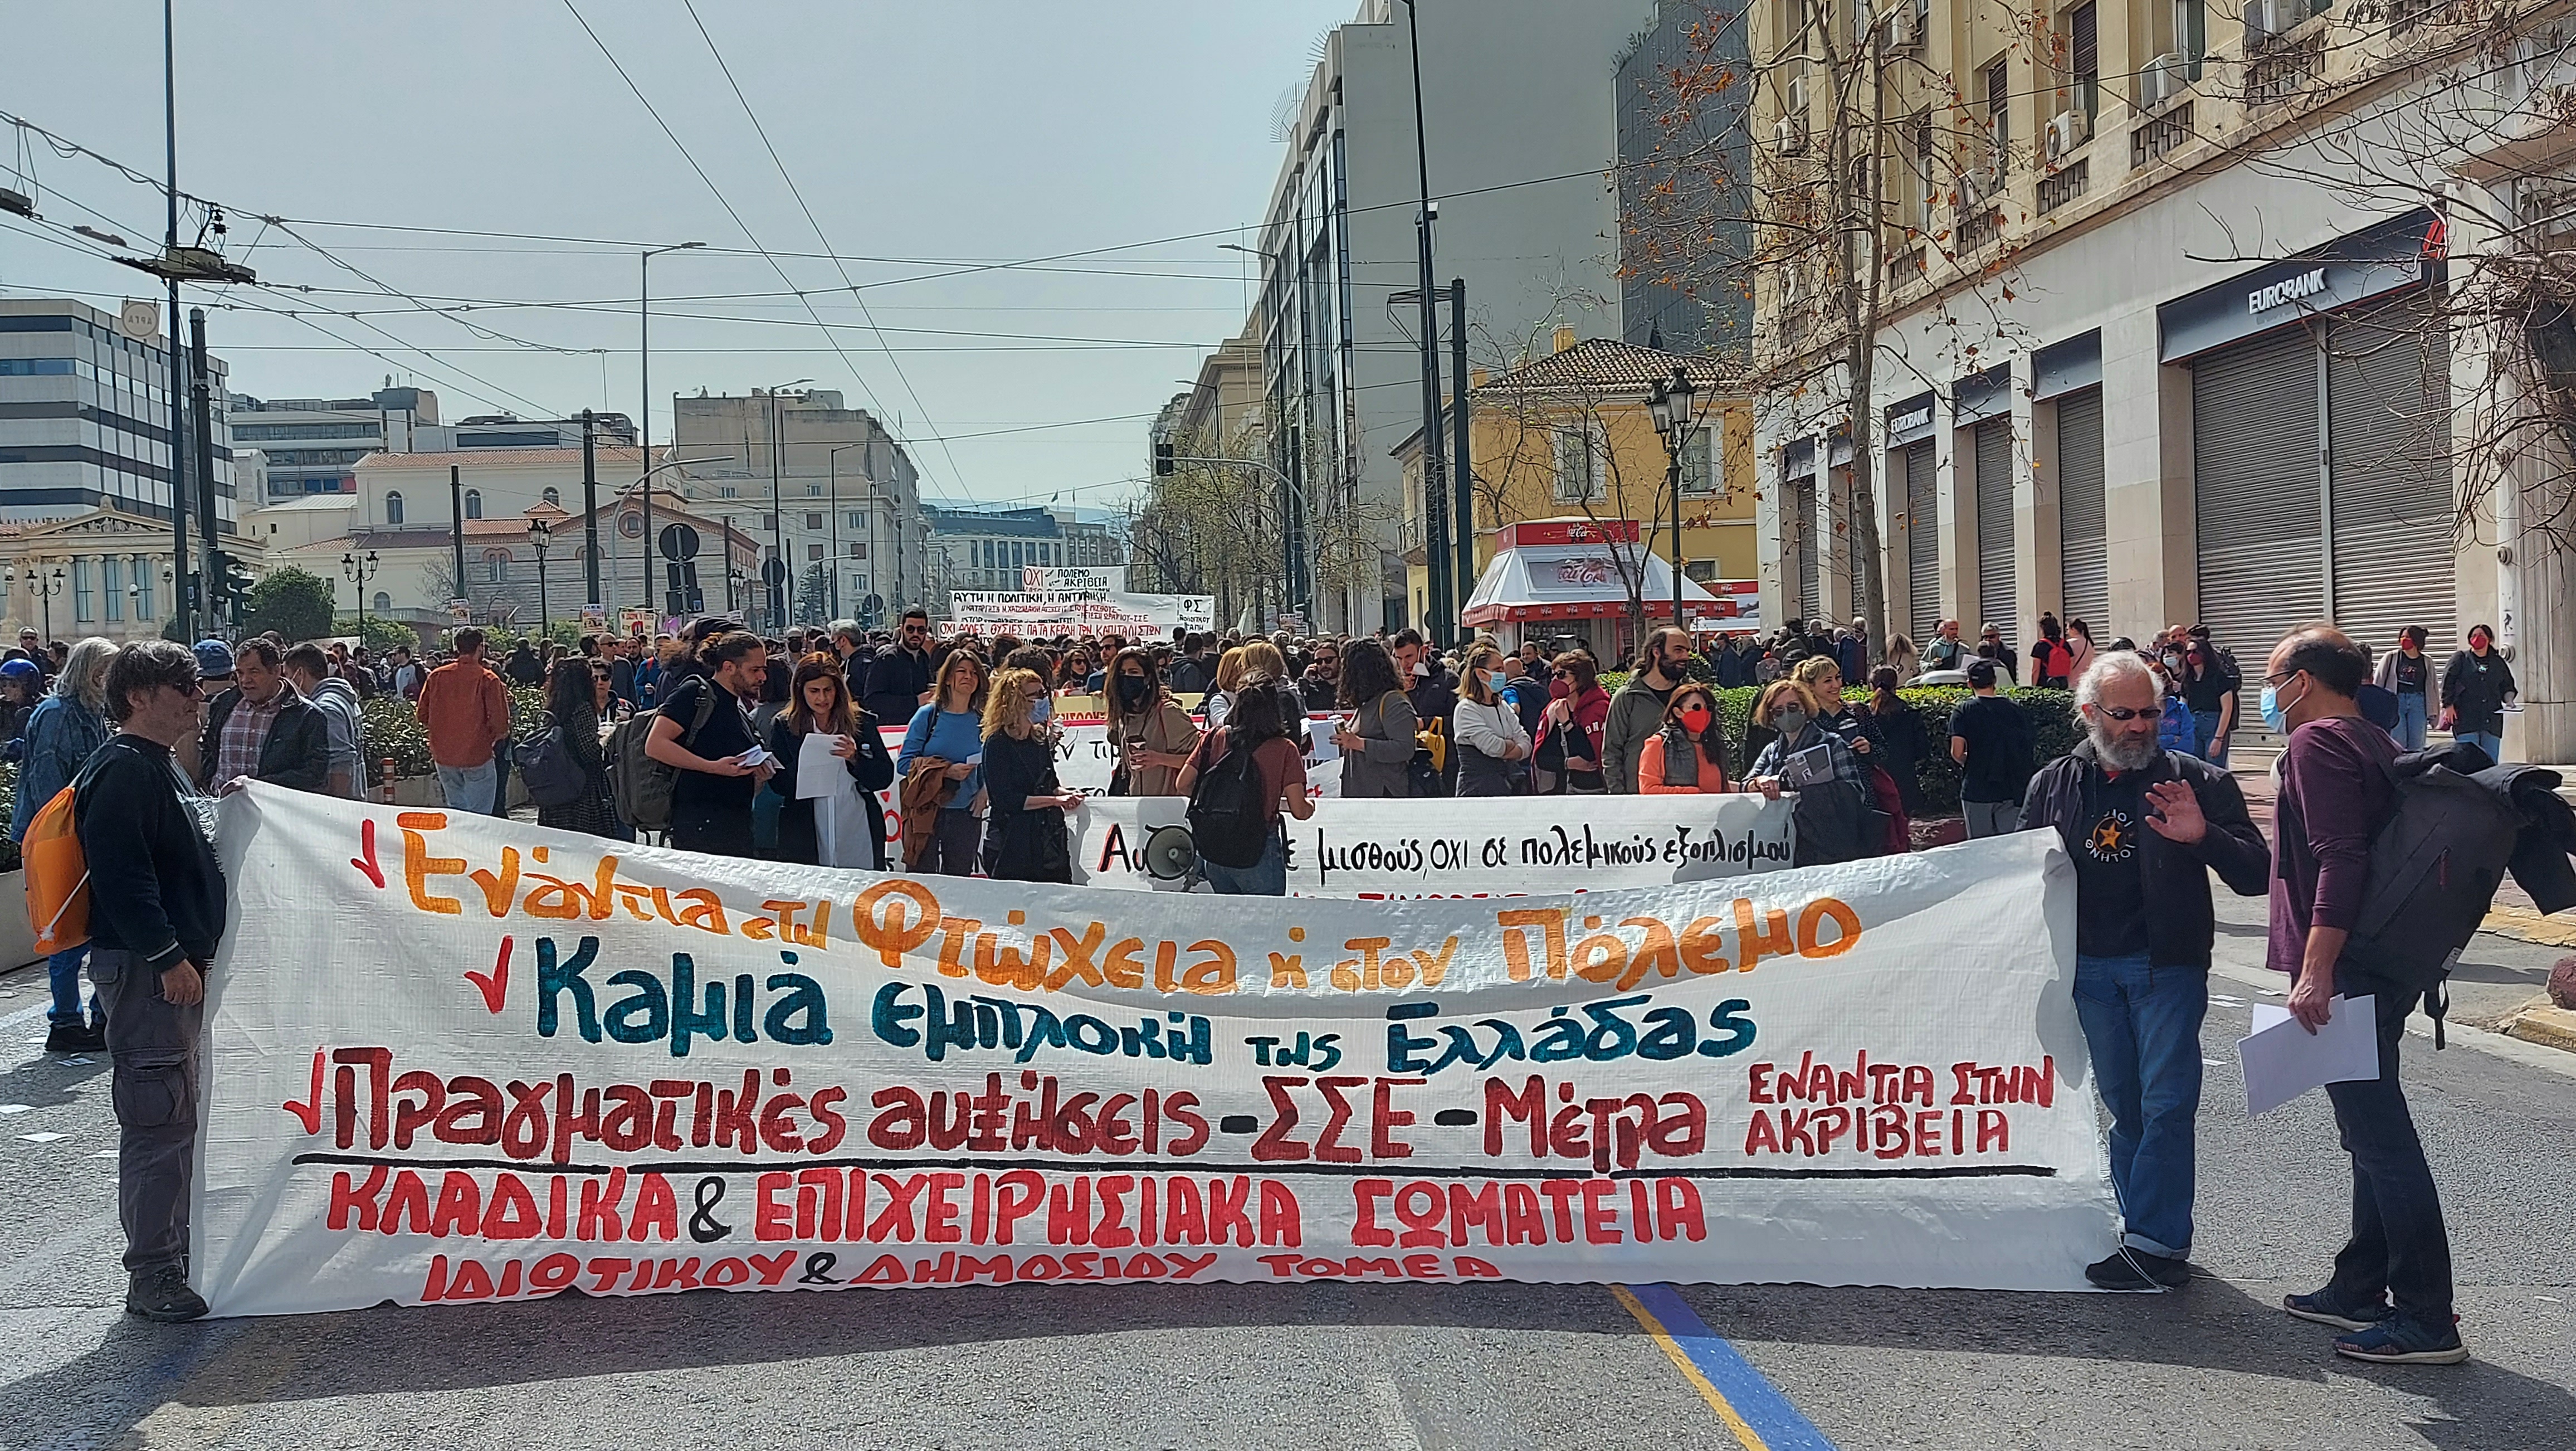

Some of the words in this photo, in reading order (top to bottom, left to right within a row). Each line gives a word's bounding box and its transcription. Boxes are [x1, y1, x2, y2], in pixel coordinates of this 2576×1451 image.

[2248, 267, 2326, 314] EUROBANK
[1891, 406, 1929, 434] EUROBANK
[954, 593, 983, 602] ΑΥΤΗ
[987, 593, 994, 602] Η
[1048, 592, 1054, 602] Η
[1023, 568, 1043, 586] ΟΧΙ
[1057, 568, 1090, 578] ΠΟΛΕΜΟ
[1063, 577, 1108, 587] ΑΚΡΙΒΕΙΑ
[1184, 599, 1206, 613] Φ.Σ.
[940, 623, 955, 634] ΟΧΙ
[991, 623, 1023, 636] ΘΥΣΙΕΣ
[1096, 624, 1162, 637] ΚΑΠΙΤΑΛΙΣΤΩΝ
[1430, 839, 1468, 870] ΟΧΙ
[1482, 836, 1509, 869] σε
[1521, 823, 1656, 870] πολεμικούς
[2085, 839, 2136, 862] ΘΝΗΤΟΙ
[397, 812, 731, 935] Ενάντια
[852, 879, 1238, 995] Φτώχεια
[1497, 897, 1862, 992] Πόλεμο
[535, 936, 834, 1058] Καμιά
[872, 982, 1213, 1064] εμπλοκή
[1244, 1031, 1342, 1073] της
[1385, 995, 1758, 1076] Ελλάδας
[1749, 1050, 1933, 1108] ΕΝΑΝΤΙΑ
[1950, 1055, 2055, 1109] ΣΤΗΝ
[333, 1046, 847, 1165] Πραγματικές
[1744, 1104, 2009, 1160] ΑΚΡΙΒΕΙΑ
[326, 1165, 679, 1243] ΚΛΑΔΙΚΑ
[689, 1175, 733, 1243] &
[754, 1167, 1302, 1248] ΕΠΙΧΕΙΡΗΣΙΑΚΑ
[1351, 1176, 1707, 1250] ΣΩΜΑΤΕΙΑ
[421, 1250, 798, 1302] ΙΔΙΩΤΙΚΟΥ
[797, 1252, 846, 1285] &
[848, 1250, 1218, 1286] ΔΗΜΟΣΙΟΥ
[1256, 1253, 1503, 1278] ΤΟΜΕΑ
